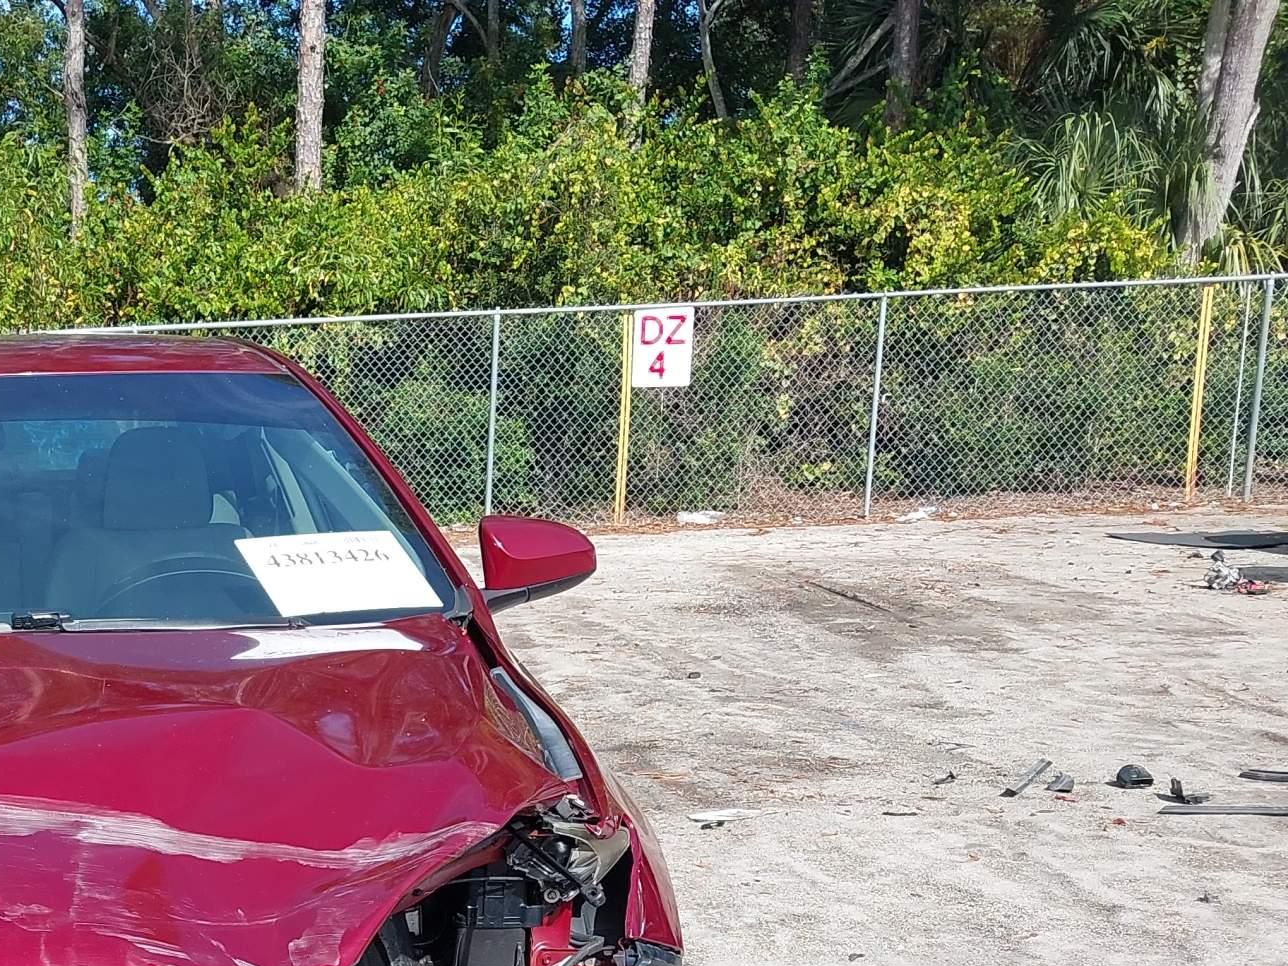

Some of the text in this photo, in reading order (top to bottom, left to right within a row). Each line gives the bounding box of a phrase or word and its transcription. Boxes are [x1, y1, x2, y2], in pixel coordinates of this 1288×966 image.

[640, 315, 686, 345] DZ
[648, 351, 665, 379] 4
[265, 548, 390, 568] 43813426
